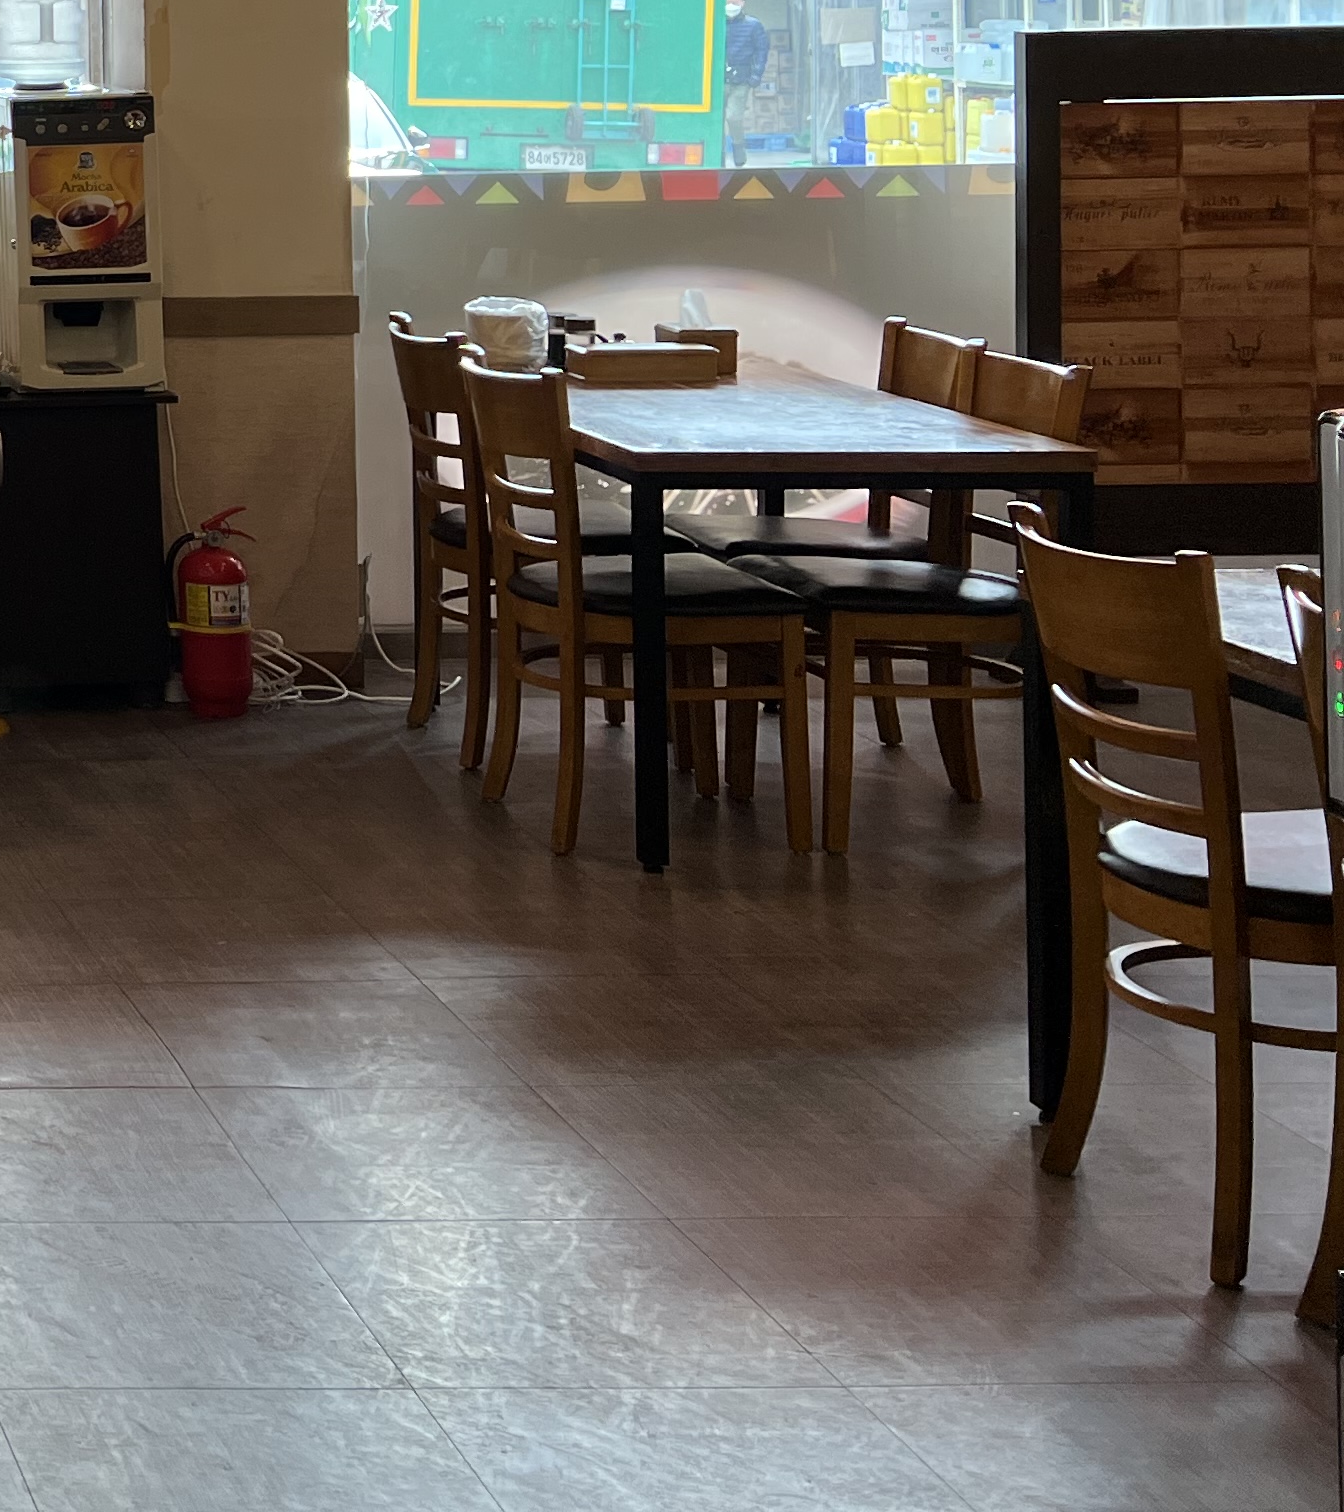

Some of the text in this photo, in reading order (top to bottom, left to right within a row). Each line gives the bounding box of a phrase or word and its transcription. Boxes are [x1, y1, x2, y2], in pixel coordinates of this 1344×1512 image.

[60, 181, 115, 193] Arabica
[1118, 355, 1164, 367] LABEL
[212, 590, 230, 602] TY
